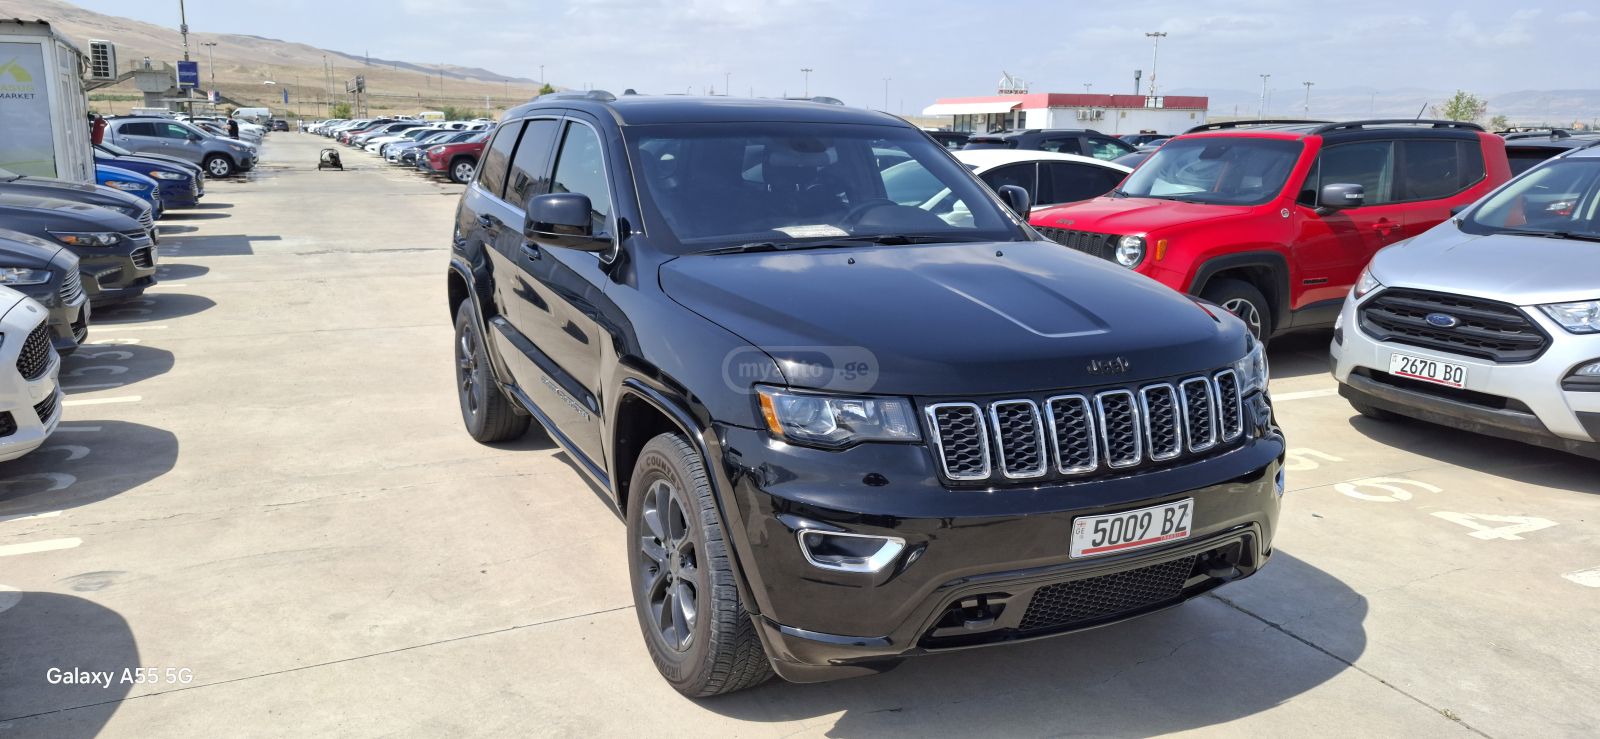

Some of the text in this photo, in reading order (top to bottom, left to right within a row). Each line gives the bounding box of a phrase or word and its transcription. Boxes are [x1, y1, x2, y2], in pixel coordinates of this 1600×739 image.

[1400, 356, 1437, 378] 2670
[1091, 503, 1189, 548] 5009 BZ
